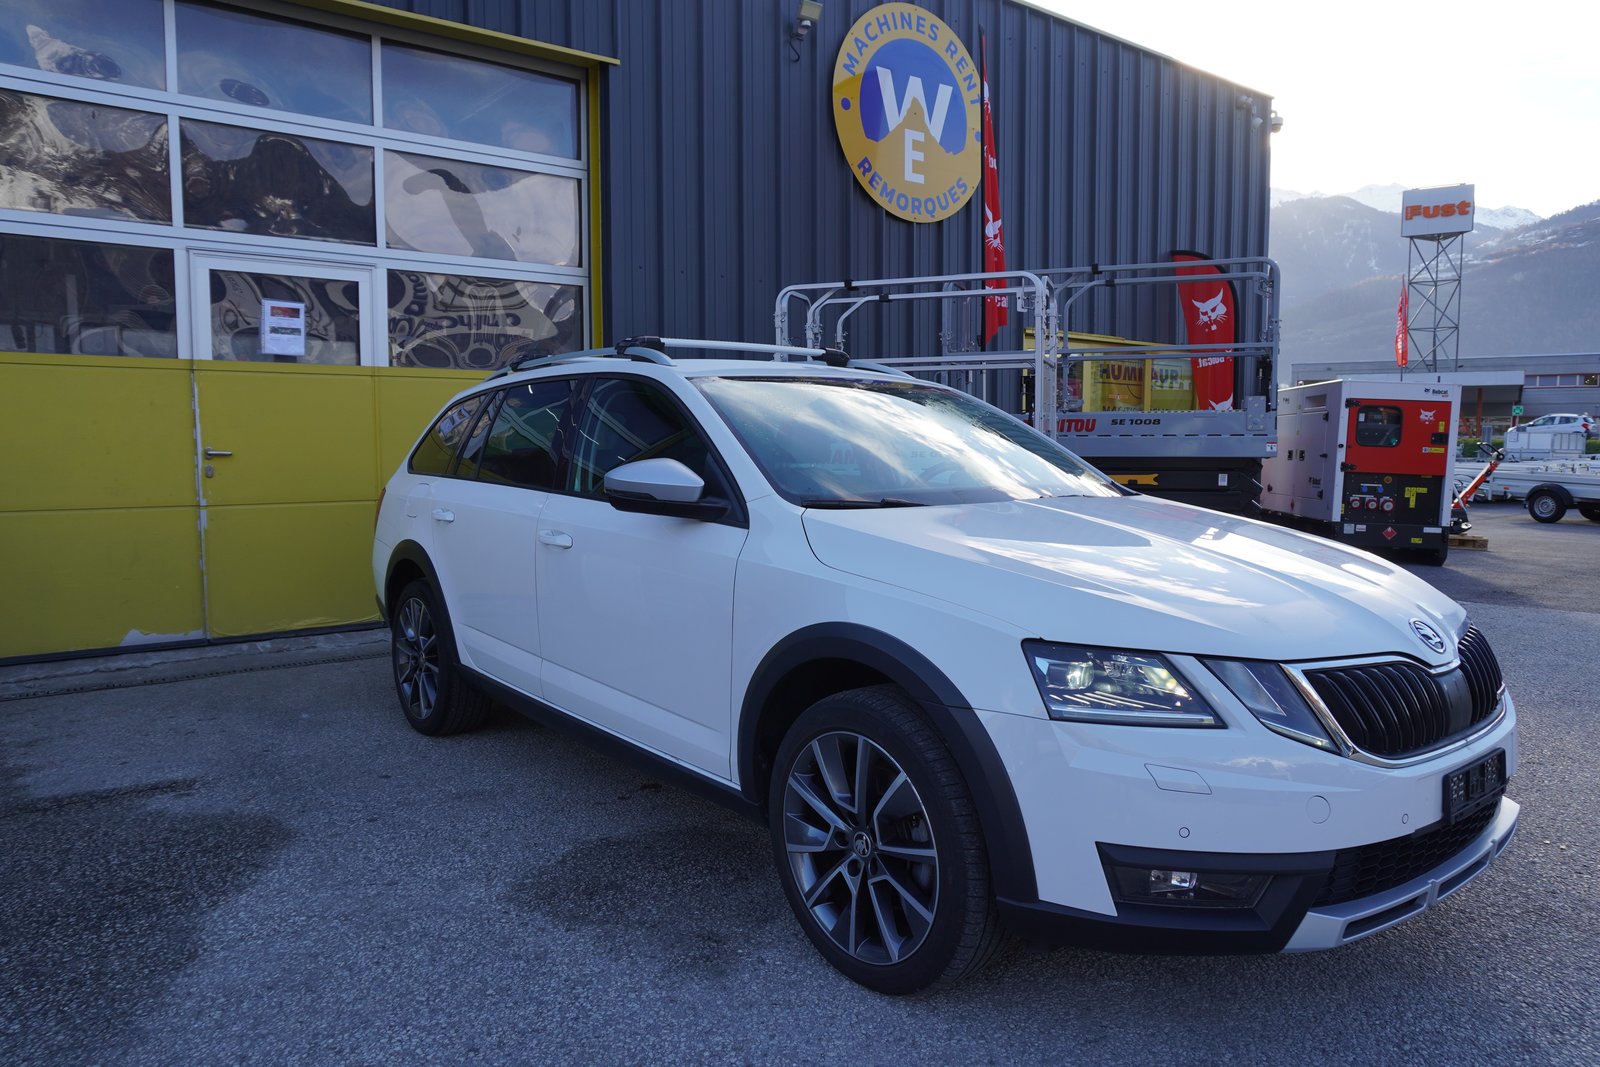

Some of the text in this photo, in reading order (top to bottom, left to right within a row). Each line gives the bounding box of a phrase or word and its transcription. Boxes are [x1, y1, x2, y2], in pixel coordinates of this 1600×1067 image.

[843, 11, 980, 107] MACHINES RENT
[904, 128, 925, 184] E
[857, 156, 968, 218] REMORQUES
[1405, 200, 1471, 221] Fust
[1111, 418, 1161, 426] SE 1008
